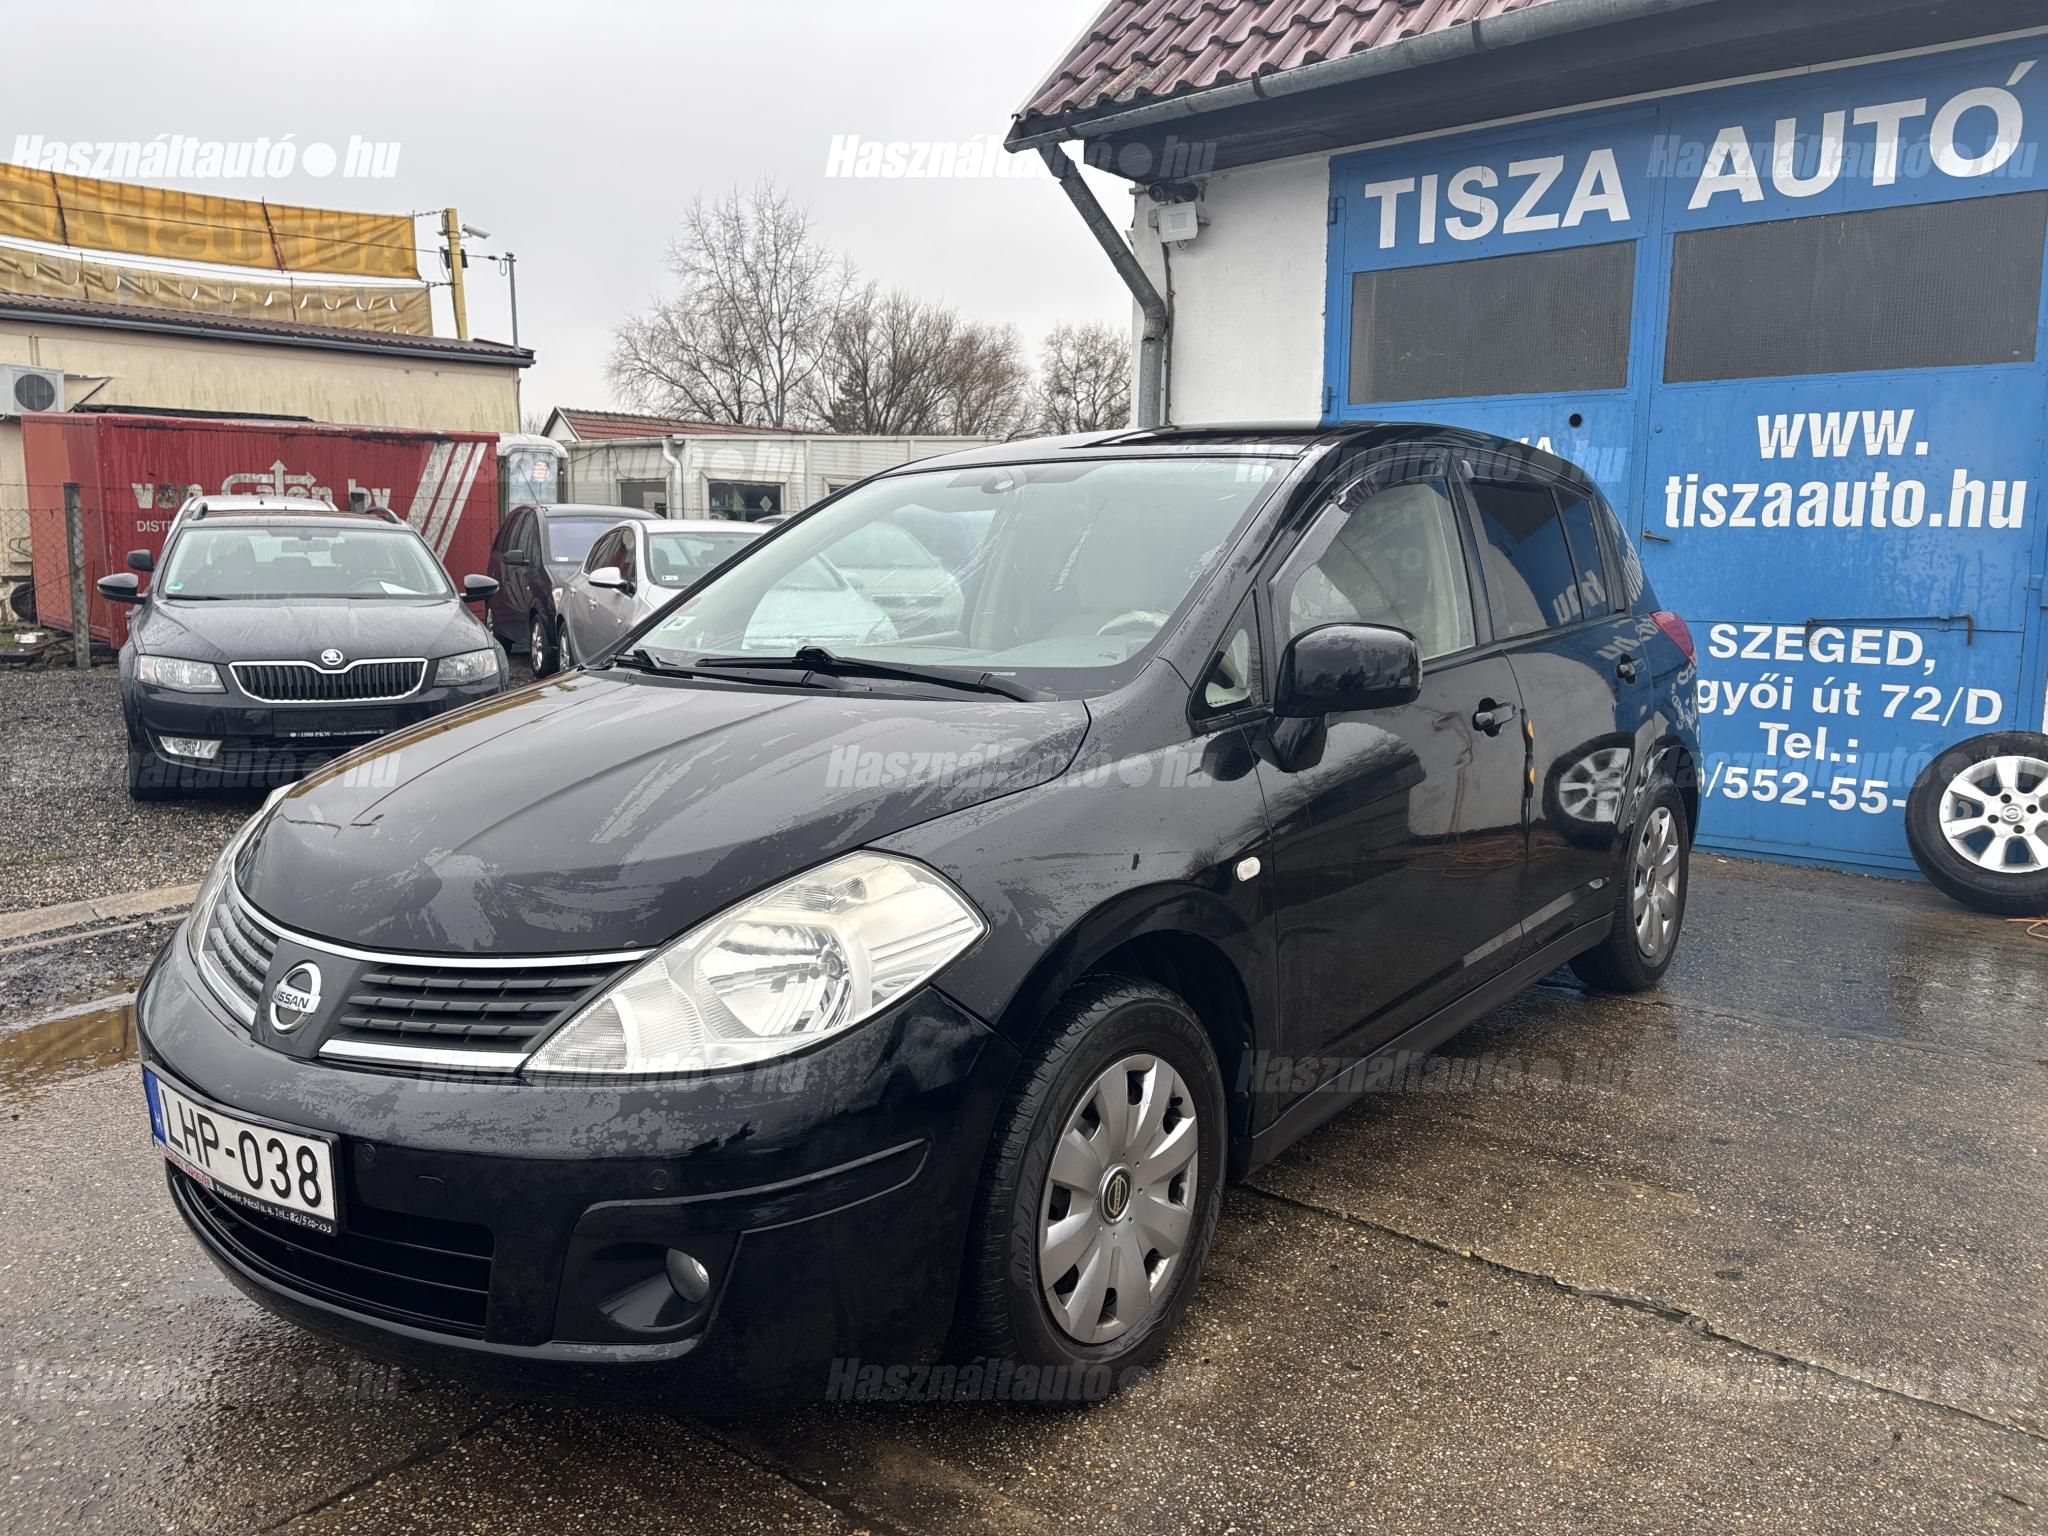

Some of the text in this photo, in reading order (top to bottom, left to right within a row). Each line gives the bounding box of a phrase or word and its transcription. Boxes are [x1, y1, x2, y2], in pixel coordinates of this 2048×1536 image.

[1364, 60, 2039, 249] TISZA AUTÓ
[1757, 409, 1929, 459] www.
[1664, 469, 2028, 529] tiszaauto.hu
[1708, 624, 1936, 676] SZEGED,
[1697, 673, 1794, 716] győi
[1812, 676, 1862, 716] út
[1881, 684, 2003, 727] 72/D
[1759, 722, 1859, 764] Tel.:
[1697, 762, 1907, 815] /552-55-
[160, 1087, 323, 1208] LHP-038
